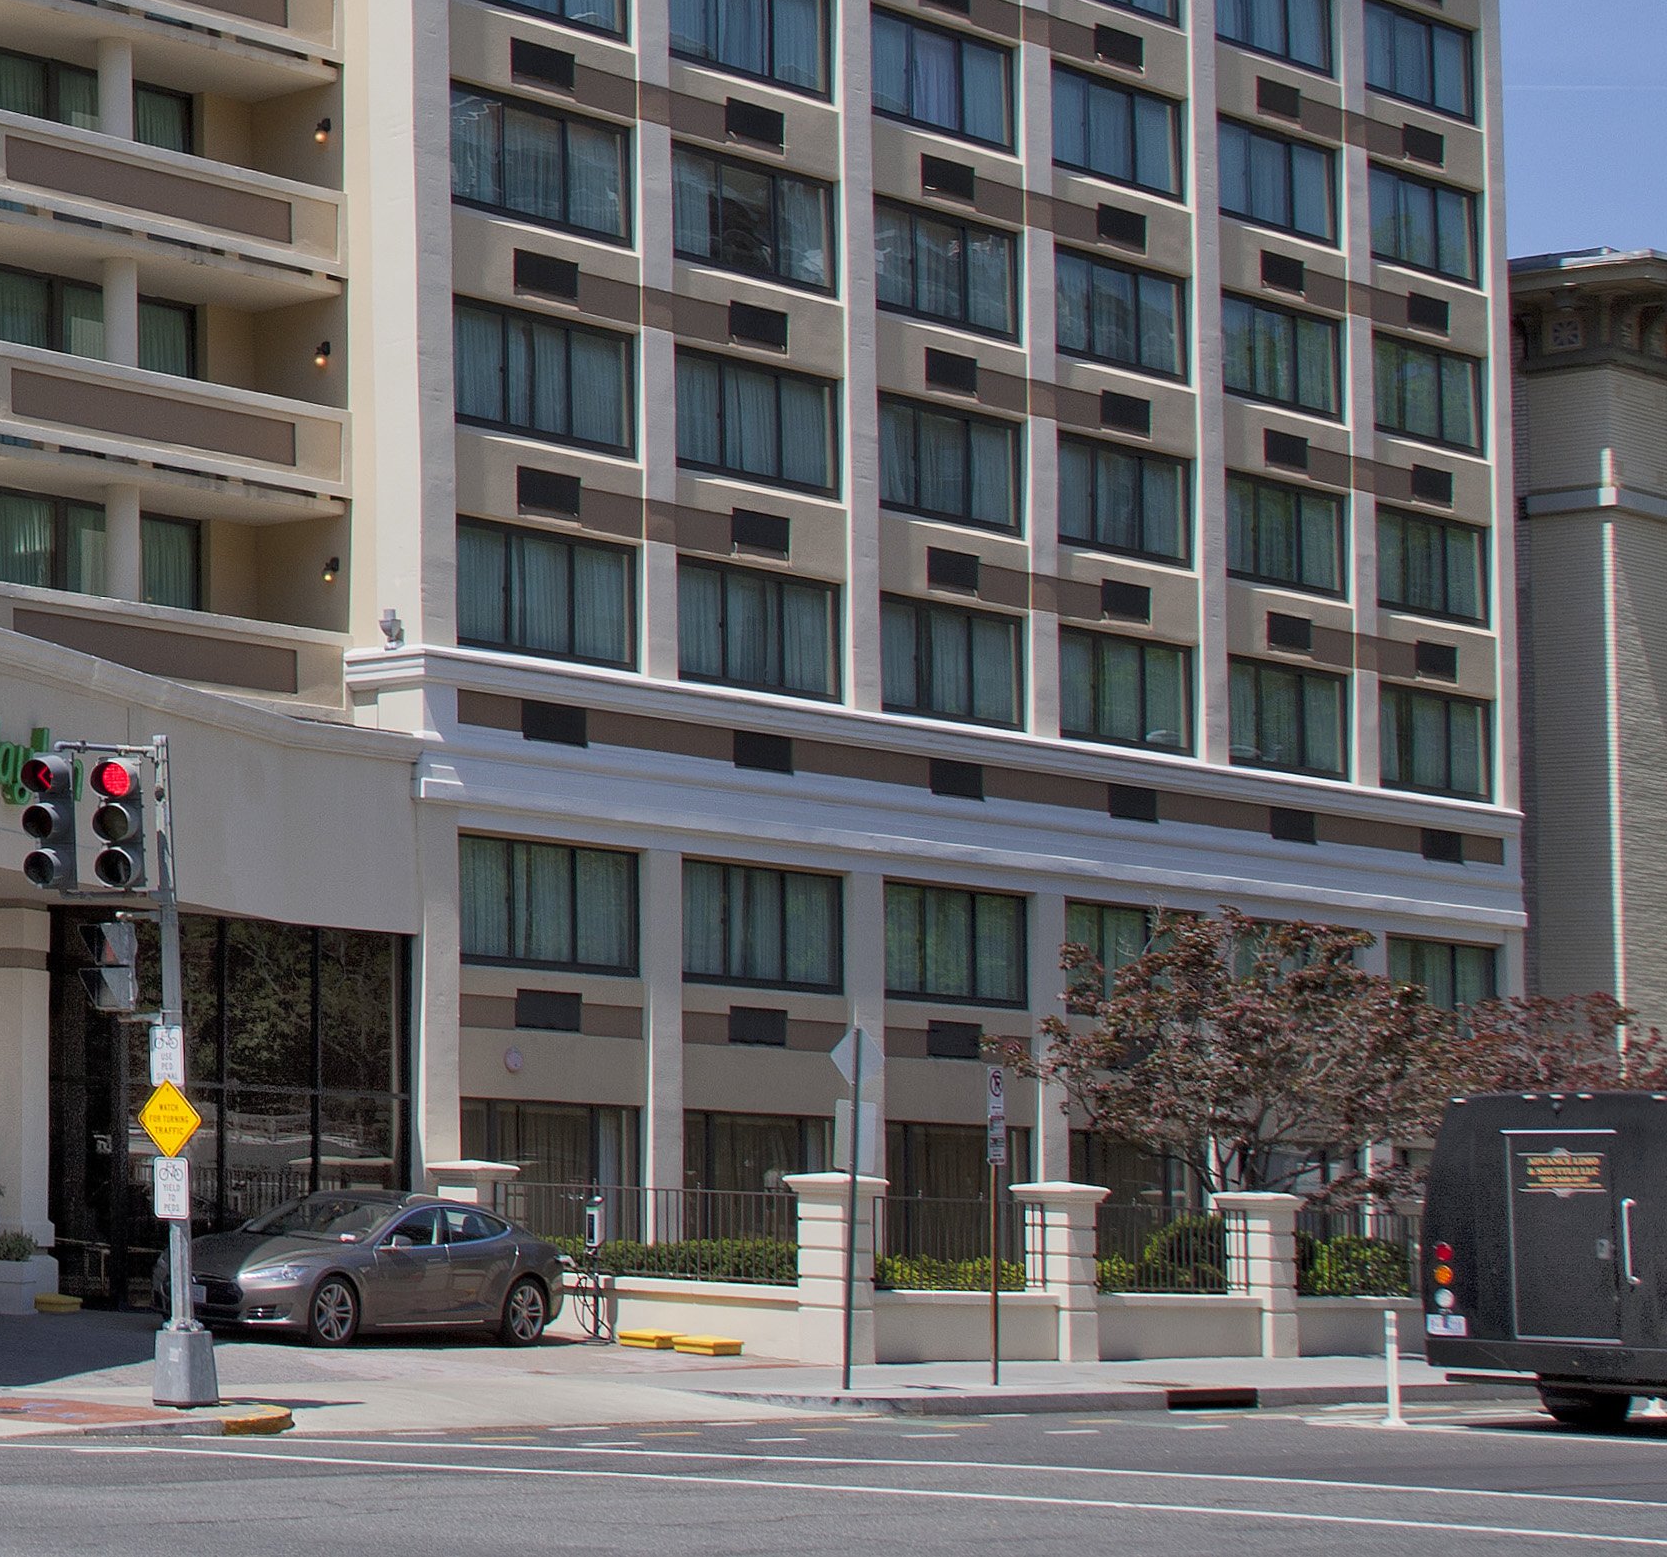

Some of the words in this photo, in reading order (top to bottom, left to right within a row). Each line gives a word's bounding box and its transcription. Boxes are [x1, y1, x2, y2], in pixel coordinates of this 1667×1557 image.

[160, 1052, 173, 1061] USE
[149, 1115, 161, 1123] FOR
[163, 1115, 189, 1124] TURNING
[155, 1126, 184, 1135] TRAFFIC
[163, 1184, 181, 1192] YIELD
[168, 1194, 176, 1202] TO
[164, 1203, 179, 1212] PEDS
